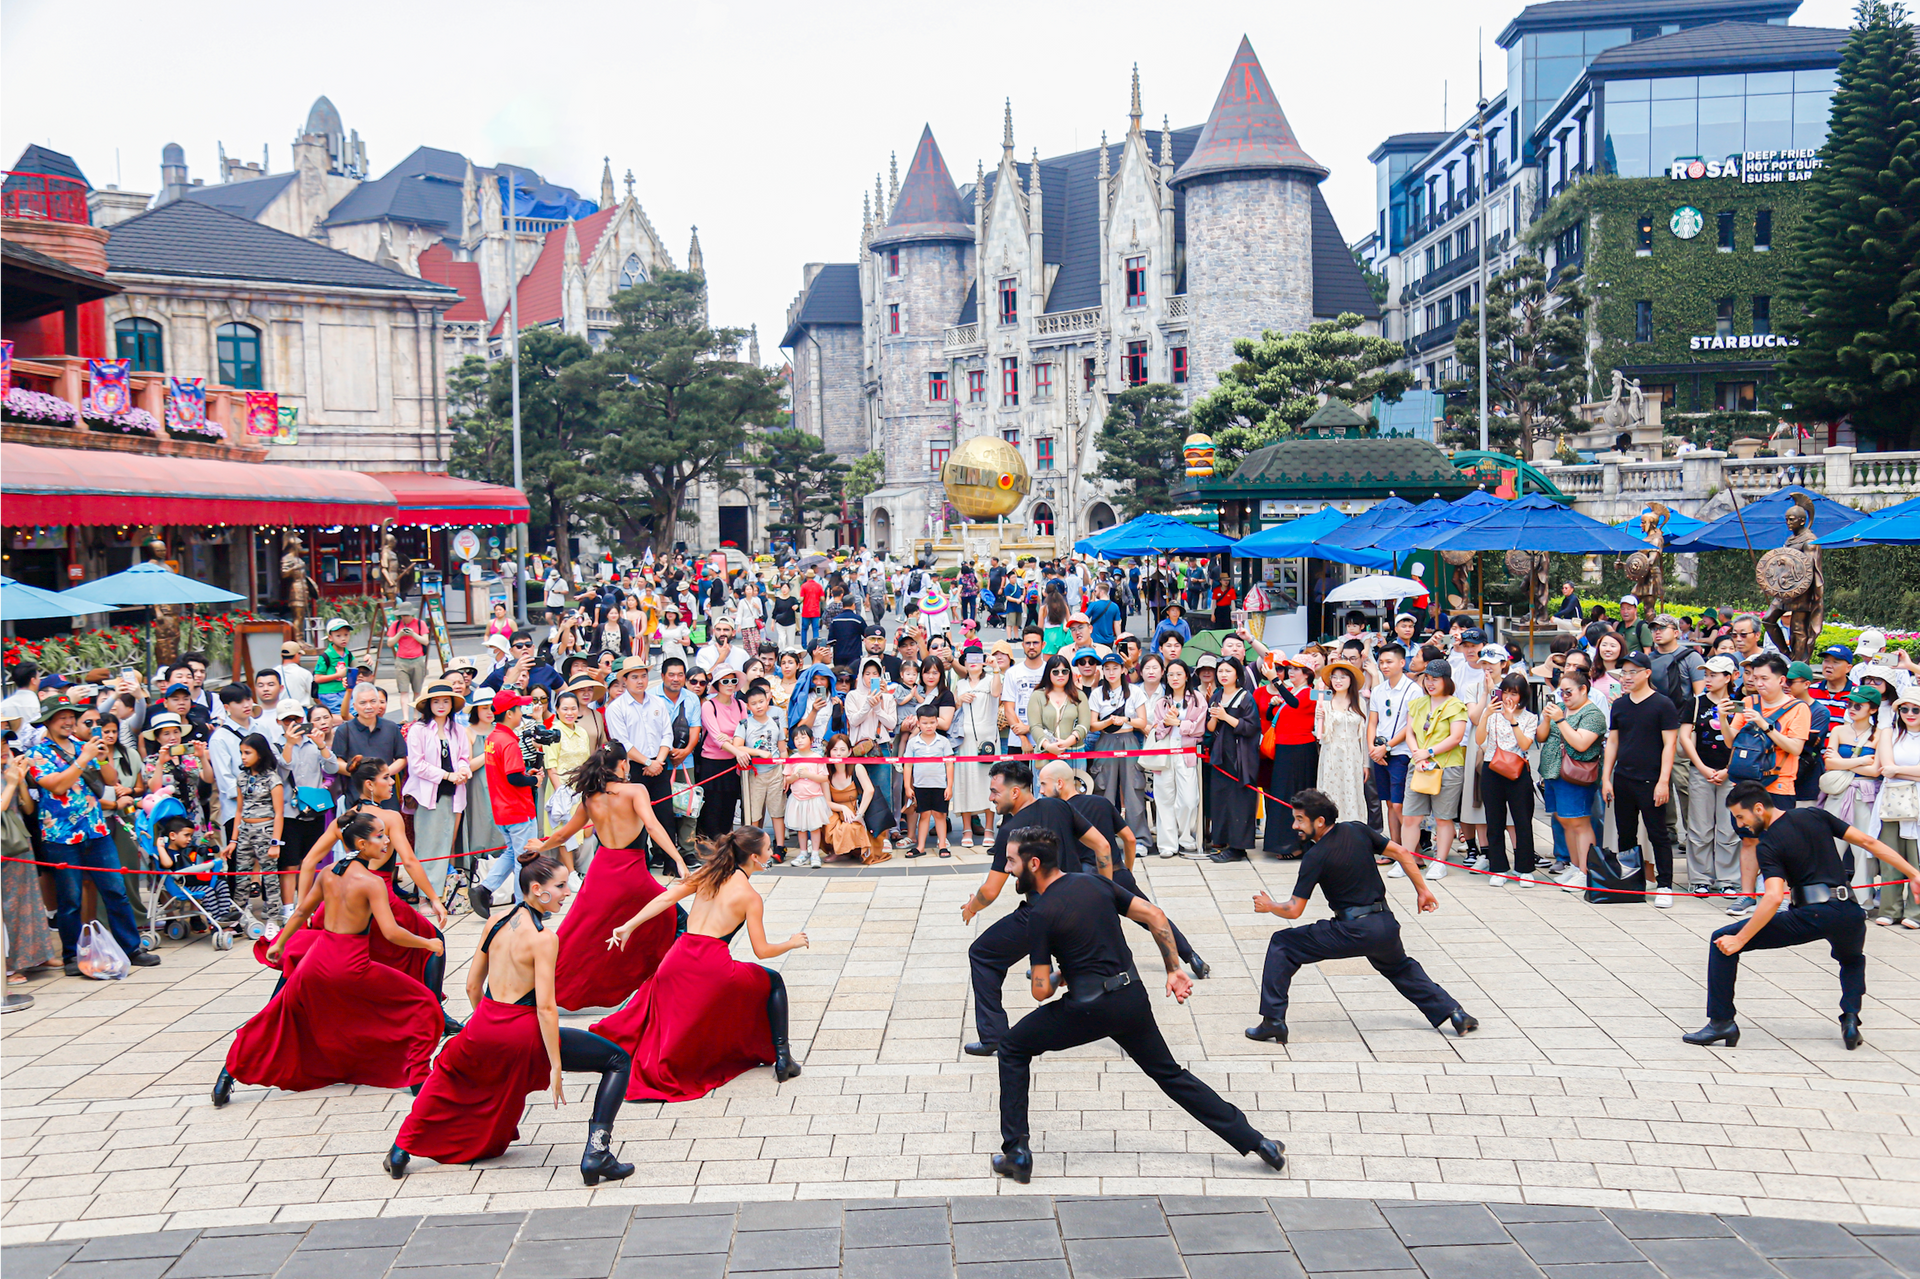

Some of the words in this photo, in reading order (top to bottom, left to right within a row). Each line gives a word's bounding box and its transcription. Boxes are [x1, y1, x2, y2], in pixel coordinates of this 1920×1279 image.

[1746, 150, 1777, 161] DEEP
[1781, 148, 1815, 159] FRIED
[1671, 160, 1739, 180] ROSA
[1746, 161, 1768, 172] HOT
[1771, 160, 1795, 171] POT
[1796, 159, 1830, 170] BUFF
[1746, 173, 1783, 184] SUSHI
[1788, 170, 1813, 182] BAR
[948, 463, 980, 486] SUN
